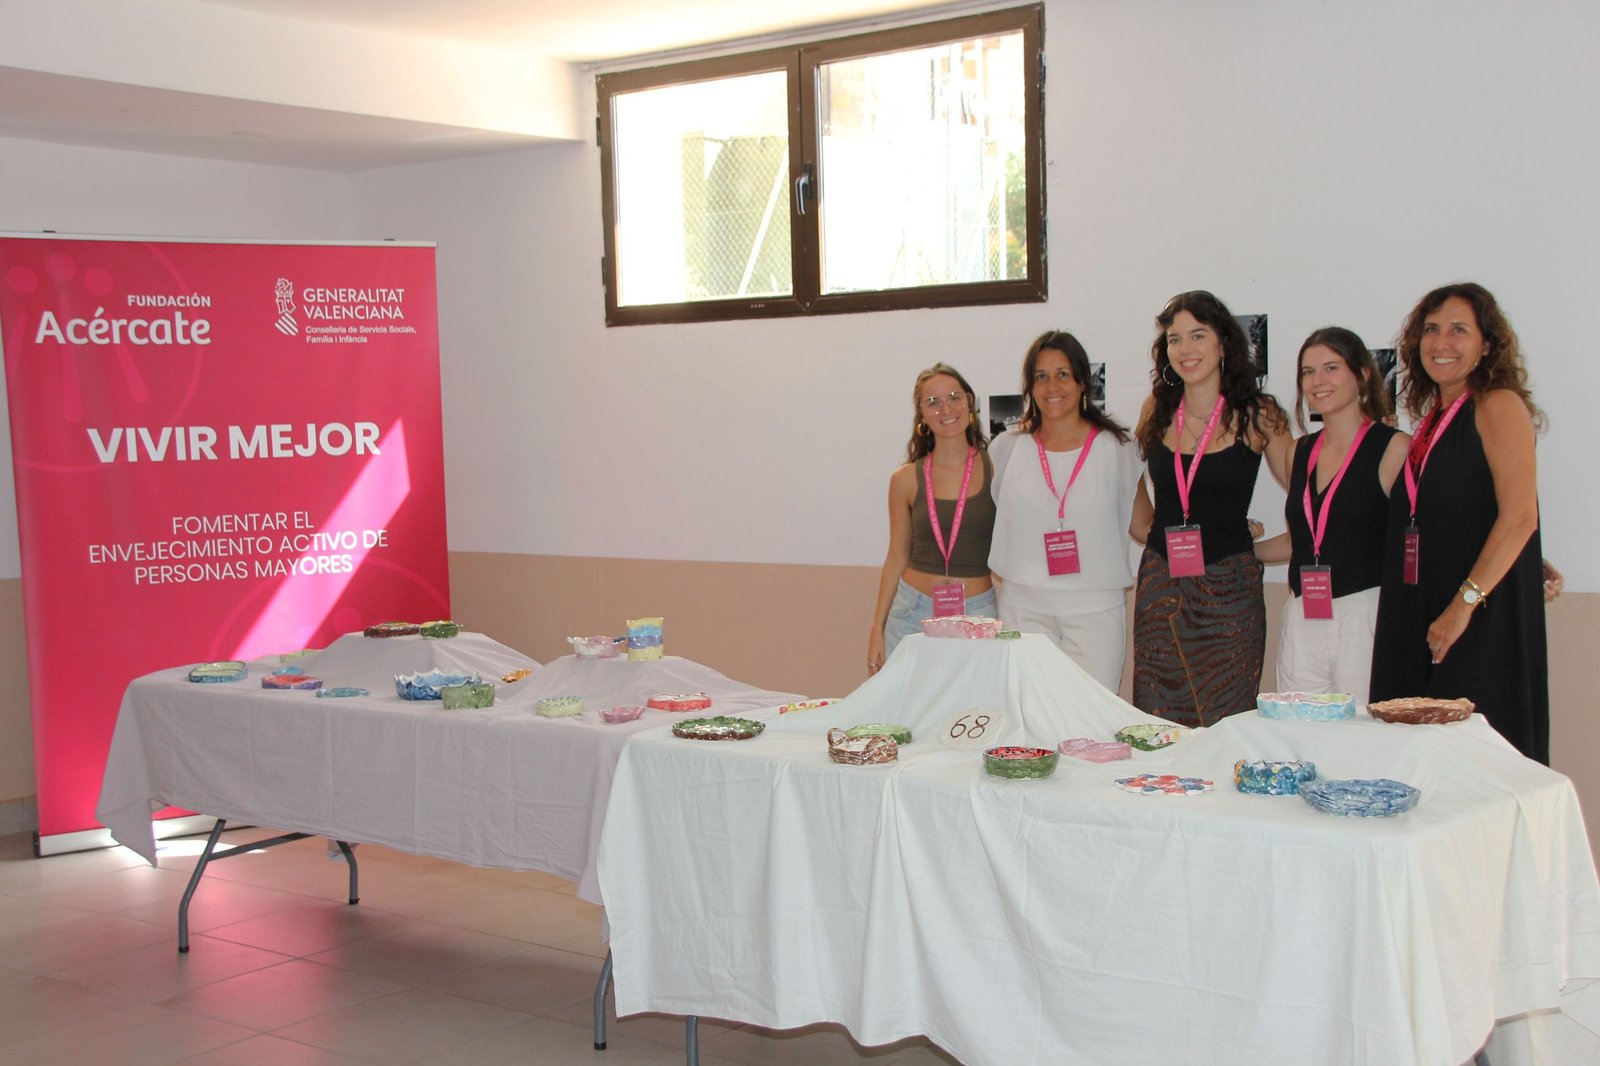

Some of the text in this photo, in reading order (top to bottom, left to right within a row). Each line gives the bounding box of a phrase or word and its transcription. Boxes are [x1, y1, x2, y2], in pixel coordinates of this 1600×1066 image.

[127, 293, 211, 307] FUNDACIÓN
[303, 288, 405, 303] GENERALITAT
[303, 305, 404, 320] VALENCIANA
[35, 306, 211, 345] Acércate
[305, 325, 347, 334] Conselleria
[348, 325, 358, 334] de
[359, 325, 388, 334] Servicis
[86, 421, 382, 463] VIVIR MEJOR
[172, 511, 315, 535] FOMENTAR EL
[89, 528, 389, 563] ENVEJECIMIENTO ACTIVO DE
[135, 554, 353, 585] PERSONAS MAYORES
[950, 714, 991, 739] 68
